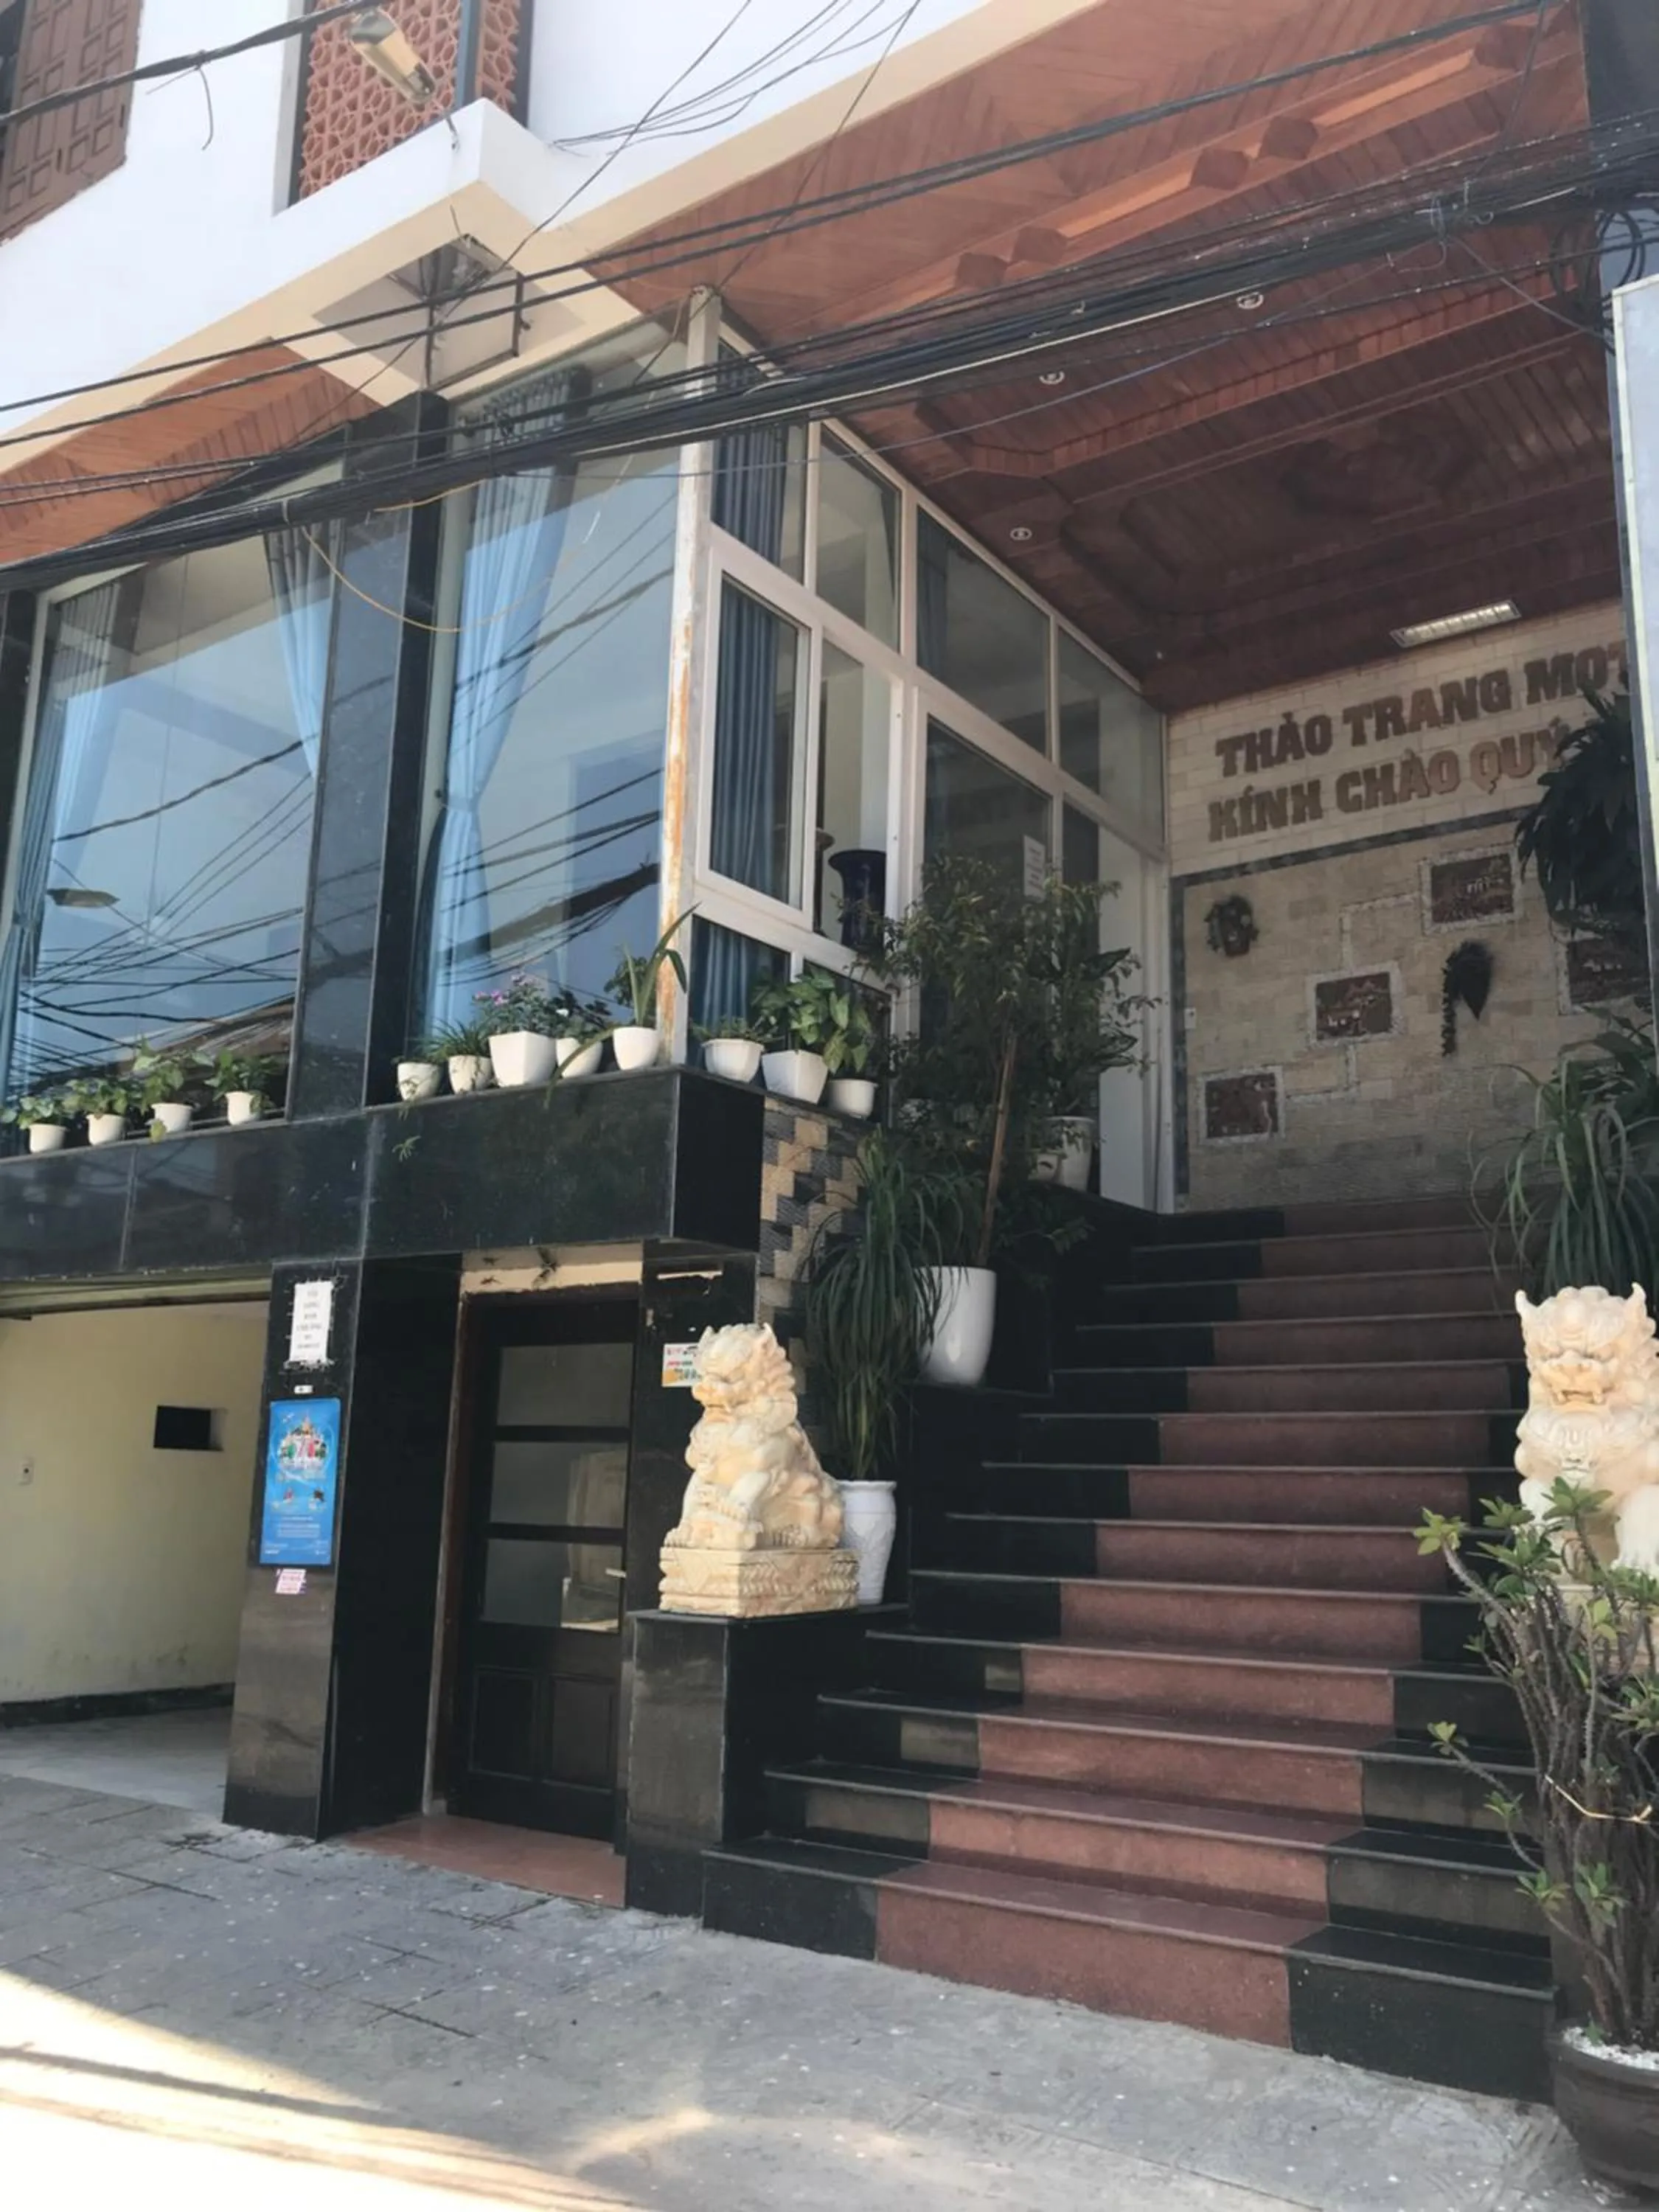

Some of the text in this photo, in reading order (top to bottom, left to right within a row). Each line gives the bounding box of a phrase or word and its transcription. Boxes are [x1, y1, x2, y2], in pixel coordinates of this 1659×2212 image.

[1215, 712, 1333, 777] THẢO
[1343, 667, 1512, 747] TRANG
[1208, 779, 1324, 843] KÍNH
[1336, 748, 1461, 814] CHÀO
